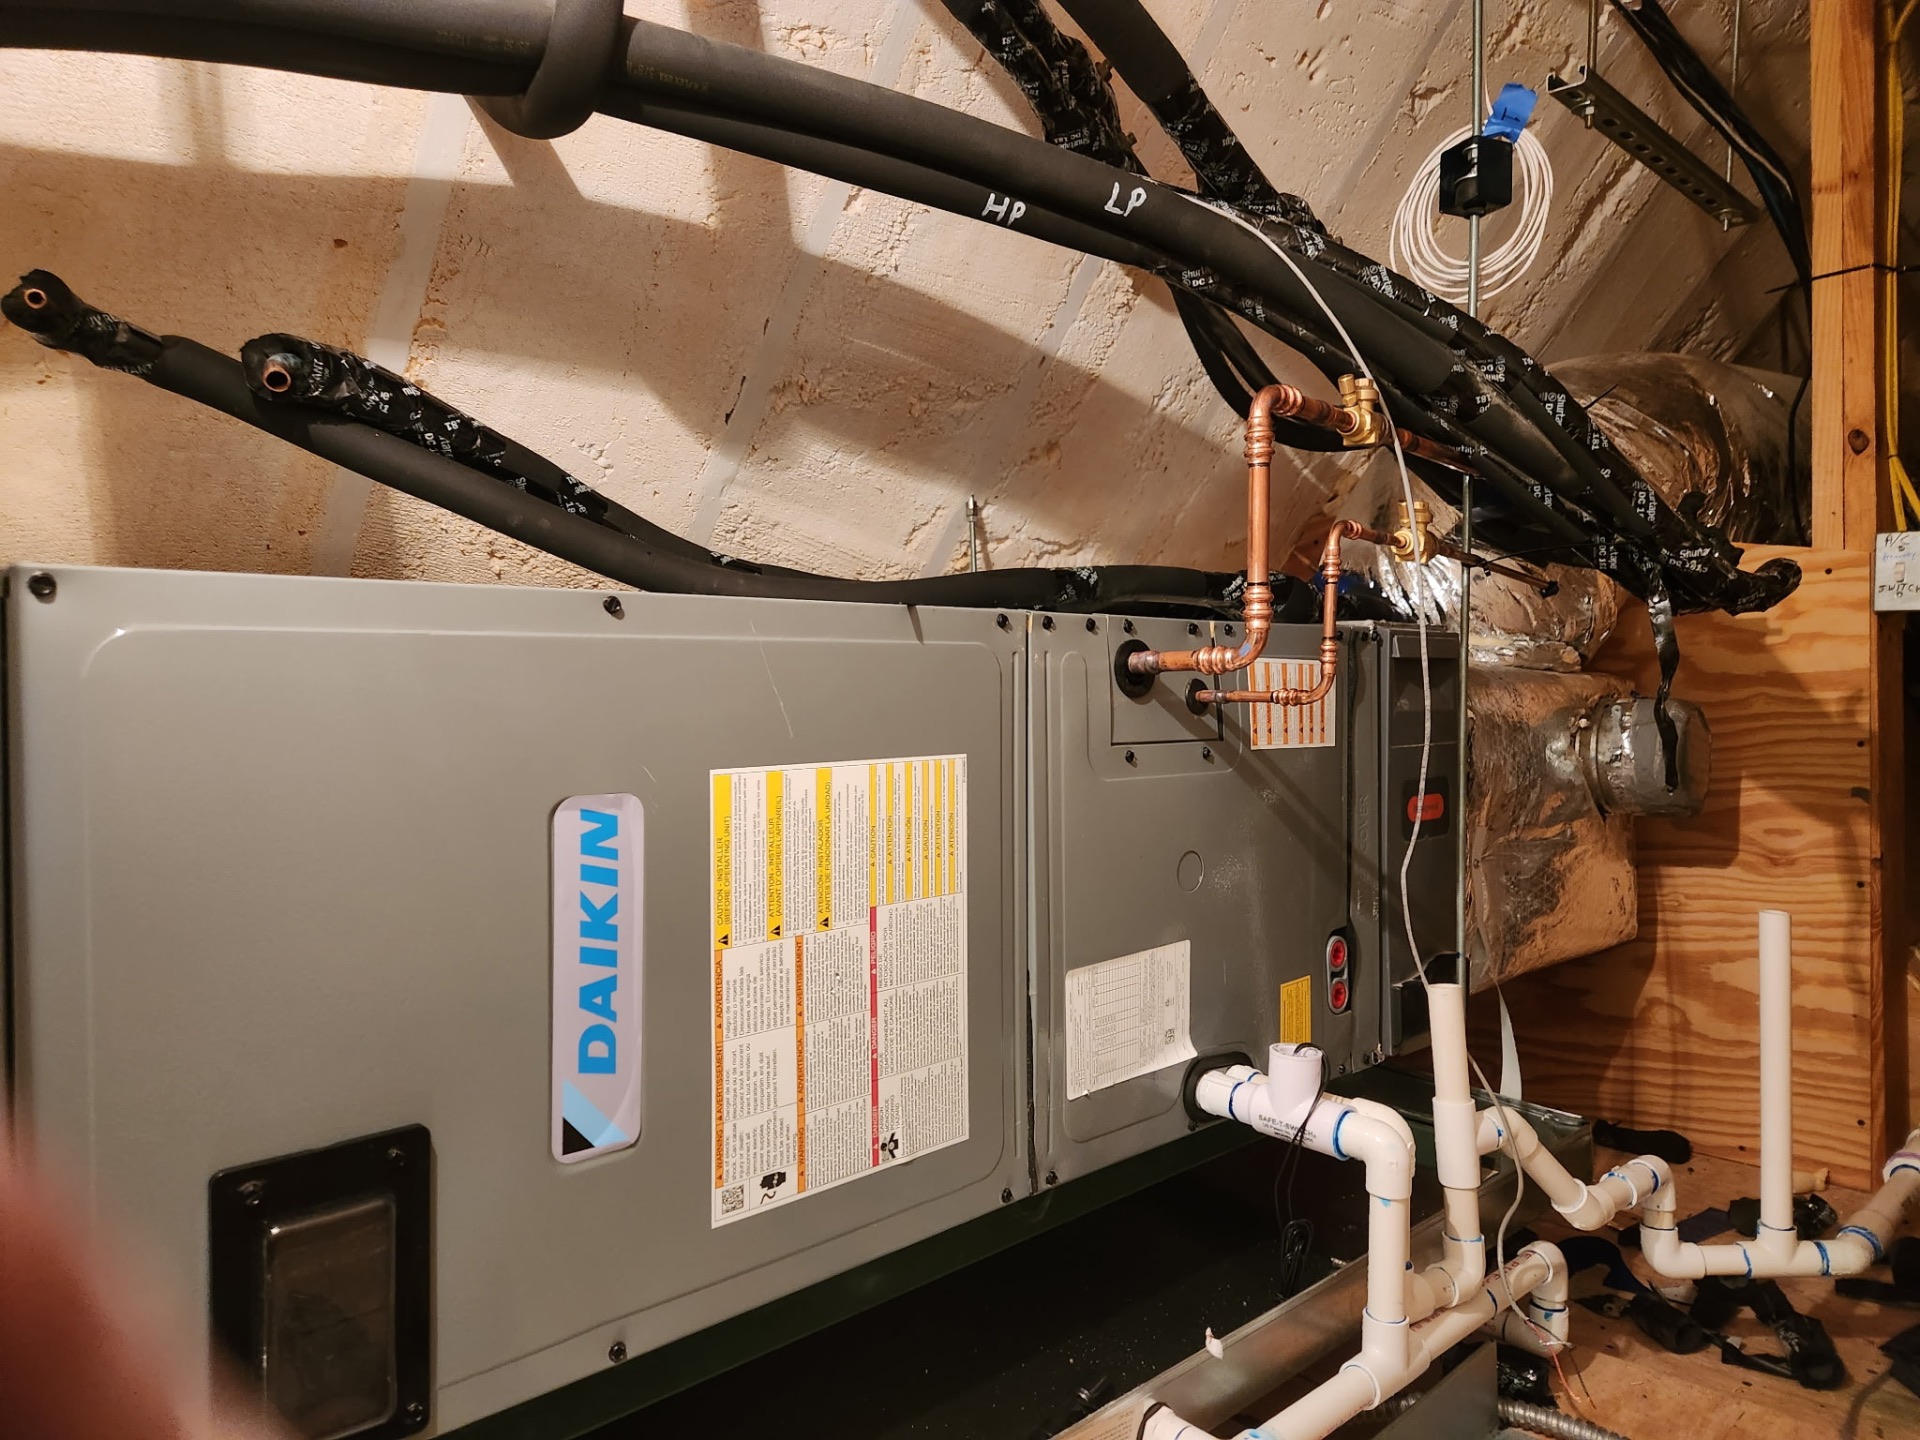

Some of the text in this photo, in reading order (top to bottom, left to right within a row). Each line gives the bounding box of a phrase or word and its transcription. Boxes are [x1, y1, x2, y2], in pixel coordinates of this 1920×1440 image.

[982, 193, 1027, 226] HP
[1105, 182, 1147, 217] LP
[1885, 532, 1911, 547] A/C
[824, 814, 830, 824] LA
[825, 872, 831, 882] DE
[578, 808, 620, 1074] DAIKIN
